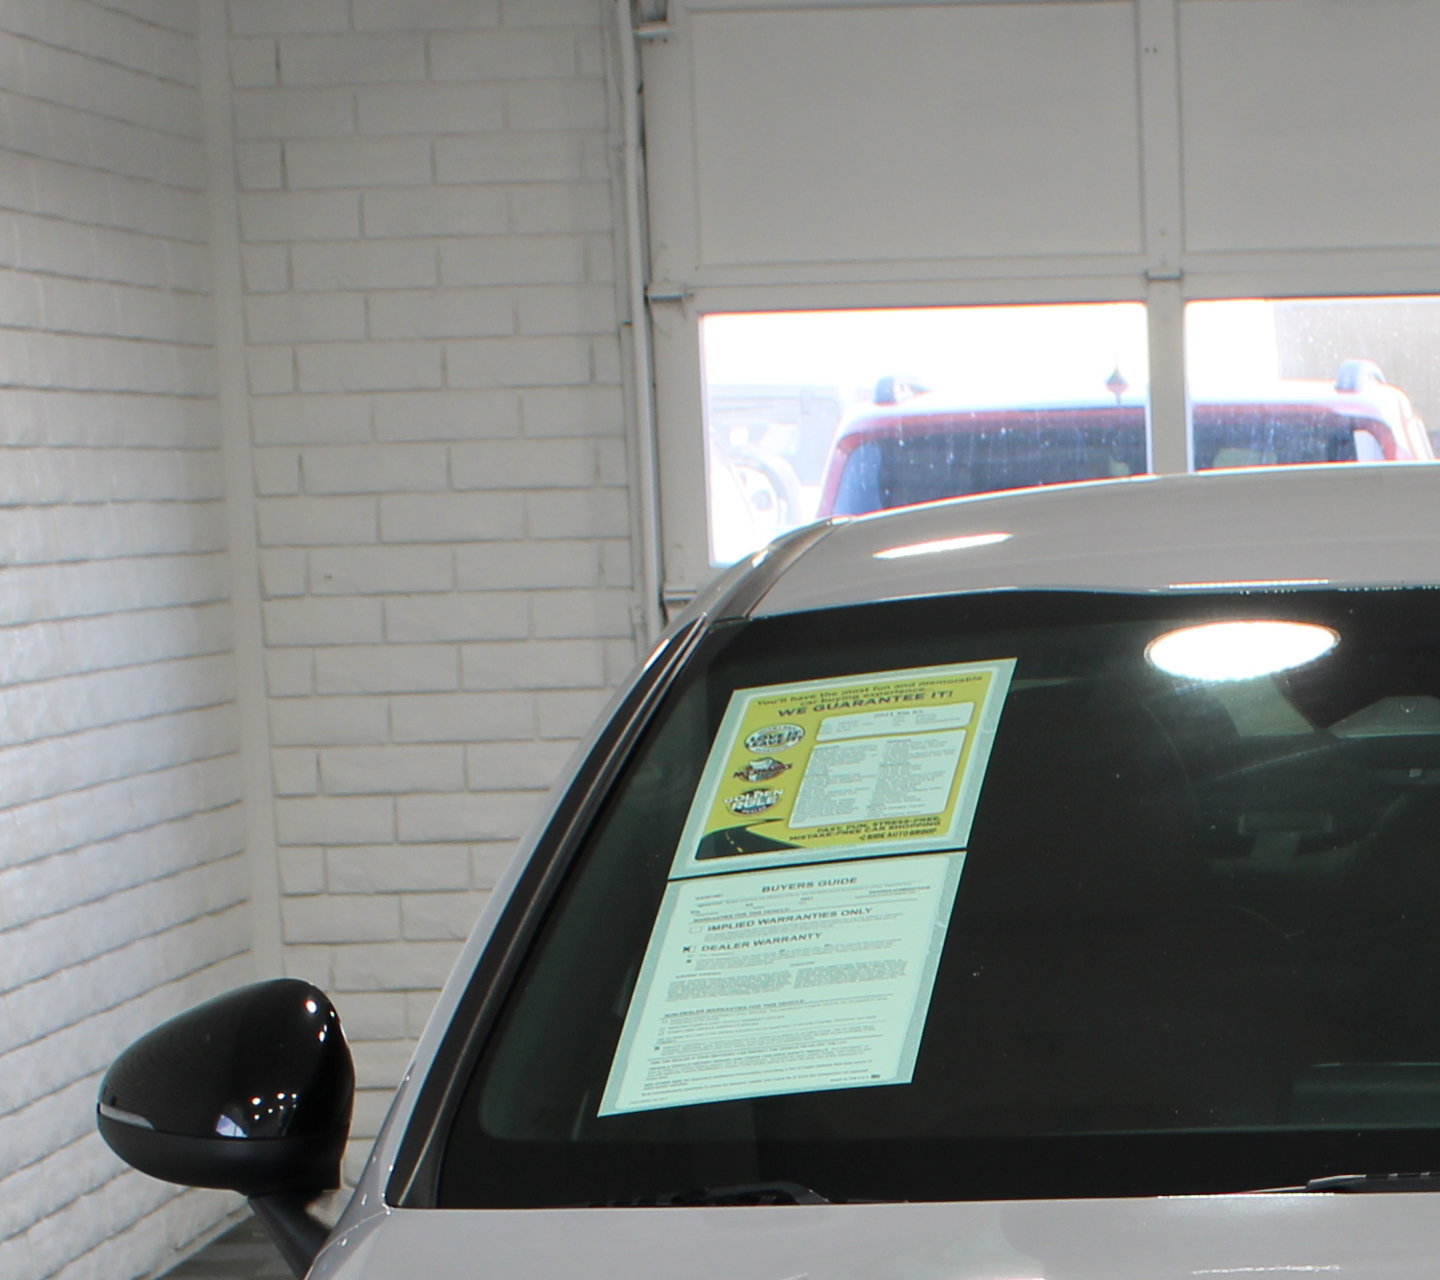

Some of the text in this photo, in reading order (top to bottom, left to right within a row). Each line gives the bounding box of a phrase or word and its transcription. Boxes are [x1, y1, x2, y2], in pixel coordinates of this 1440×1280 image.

[790, 694, 816, 702] have
[820, 690, 839, 698] the
[841, 687, 869, 696] most
[873, 684, 891, 692] fun
[894, 681, 916, 690] and
[918, 675, 983, 688] memorable
[778, 690, 954, 717] WE GUARANTEE IT!
[820, 694, 861, 705] buying
[724, 789, 785, 803] GOLDEN
[731, 797, 777, 810] RULE
[887, 830, 908, 838] AUTO
[761, 876, 858, 893] BUYERS GUIDE
[707, 907, 874, 932] IMPLIED WARRANTIES ONLY
[701, 941, 750, 952] DEALER
[753, 932, 822, 946] WARRANTY
